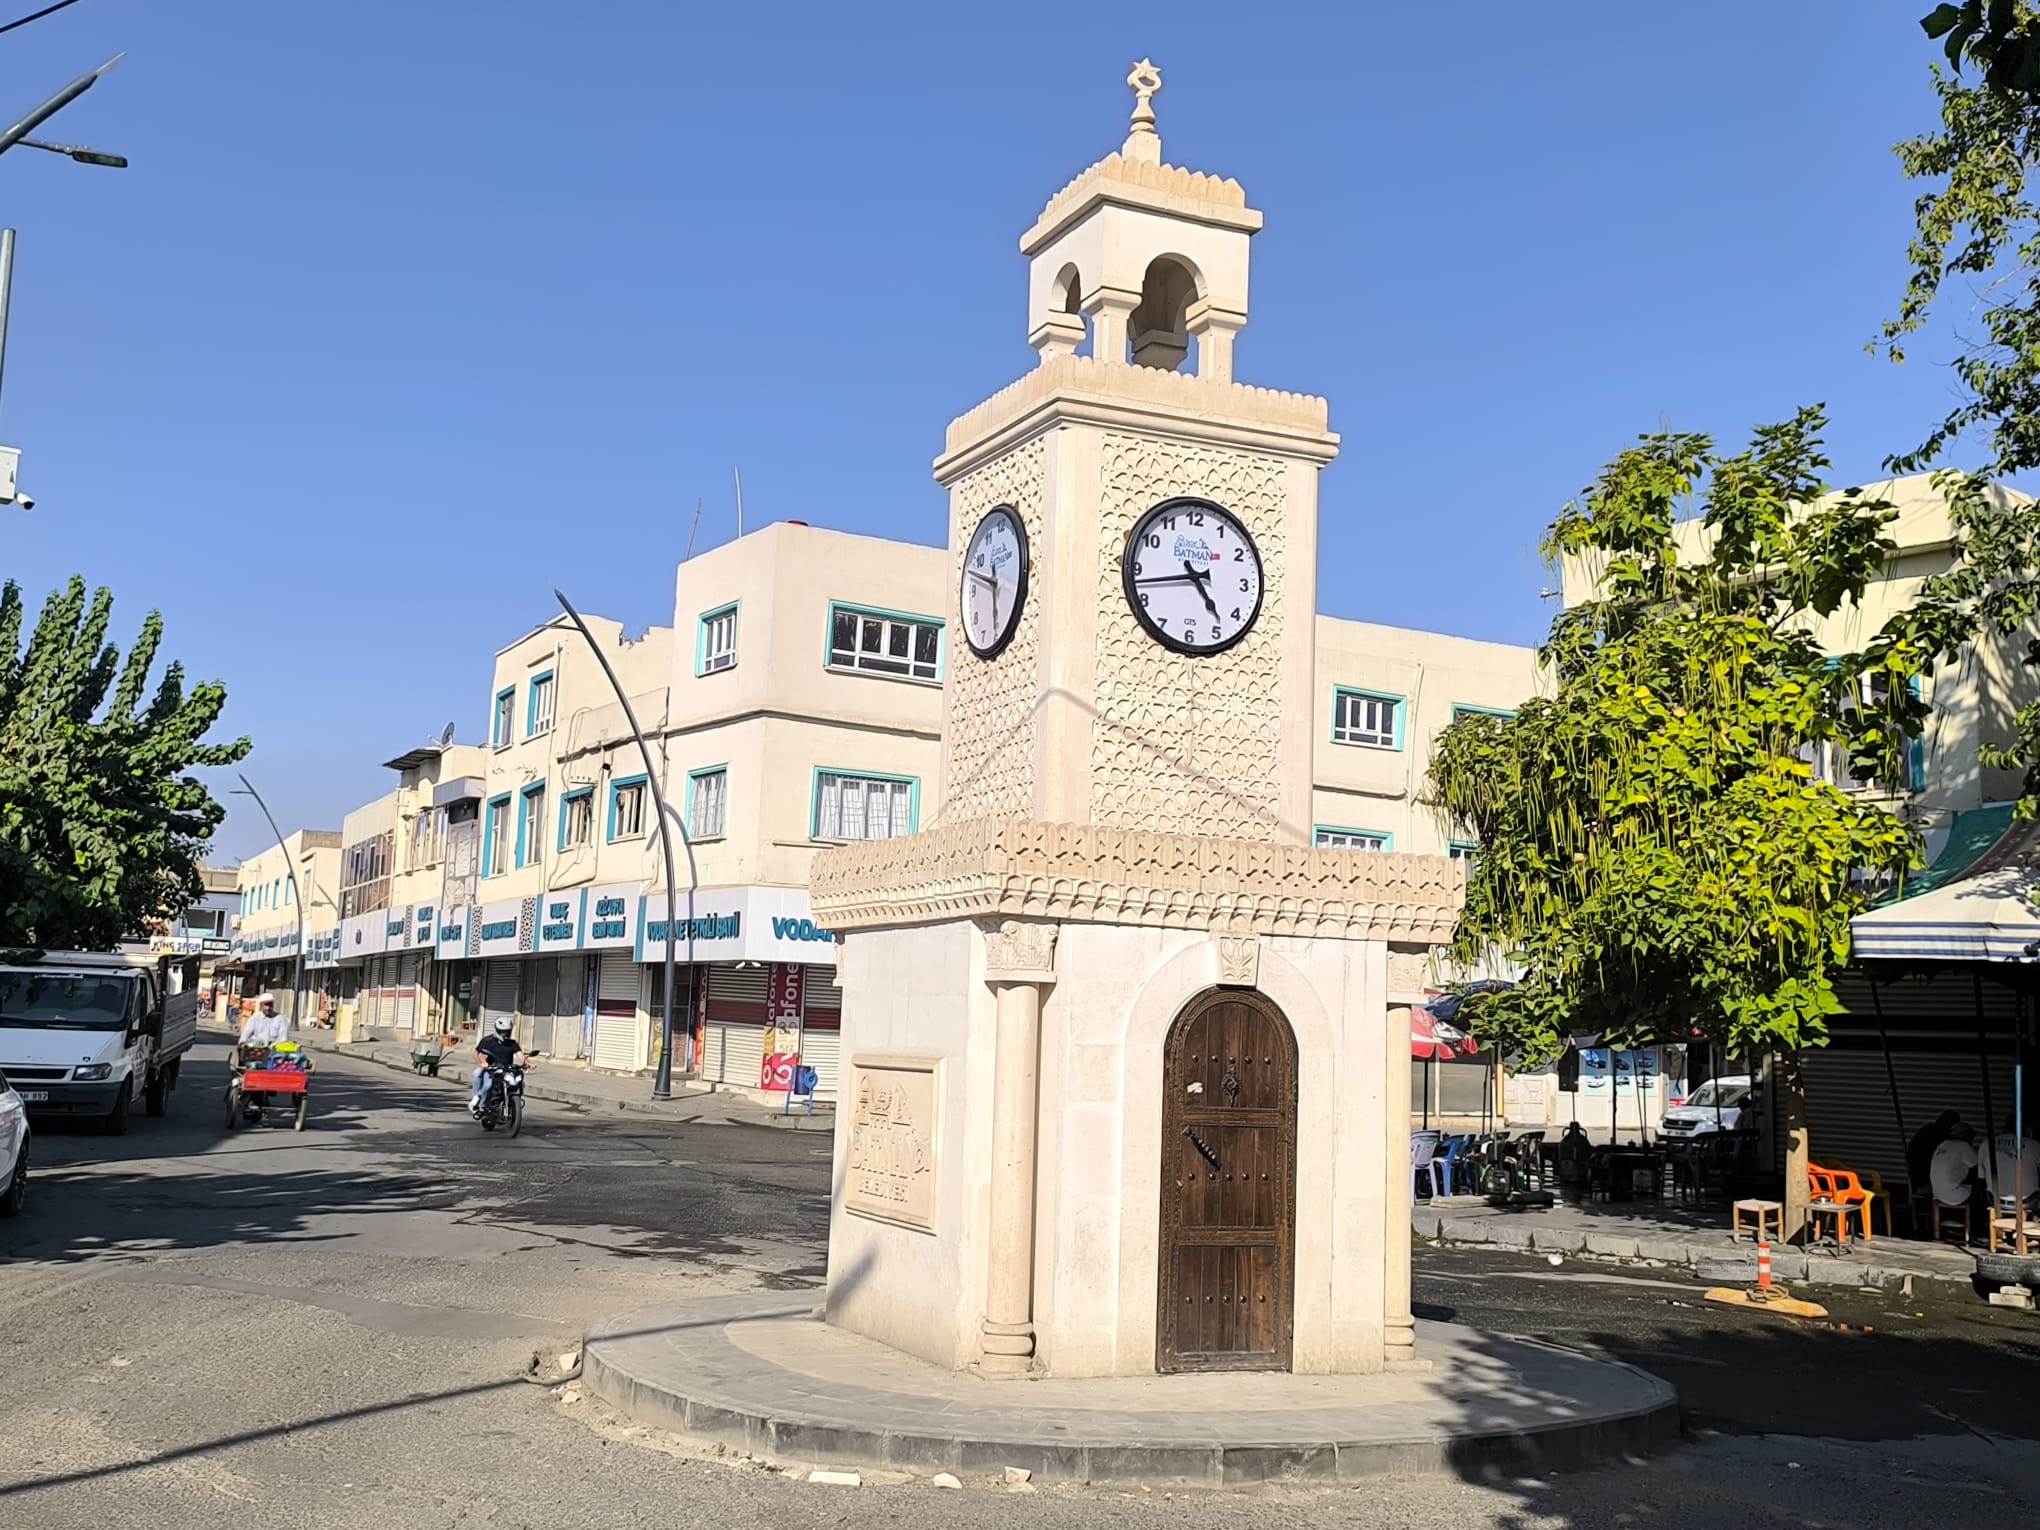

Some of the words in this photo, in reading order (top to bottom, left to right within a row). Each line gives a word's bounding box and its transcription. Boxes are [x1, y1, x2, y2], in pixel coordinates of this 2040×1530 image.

[997, 518, 1006, 533] 12
[1160, 516, 1176, 531] 11
[1186, 511, 1204, 527] 12
[984, 531, 993, 546] 11
[1217, 525, 1225, 538] 1
[1143, 534, 1160, 549] 10
[1173, 546, 1213, 561] BATMAN
[1234, 548, 1244, 562] 2
[976, 553, 985, 569] 10
[1133, 561, 1143, 576] 9
[971, 584, 977, 598] 9
[1239, 578, 1249, 592] 3
[1140, 593, 1149, 608] 8
[973, 611, 979, 625] 8
[1230, 607, 1241, 621] 4
[1157, 617, 1168, 631] 7
[980, 629, 987, 642] 7
[1184, 629, 1194, 643] 6
[1211, 626, 1222, 640] 5
